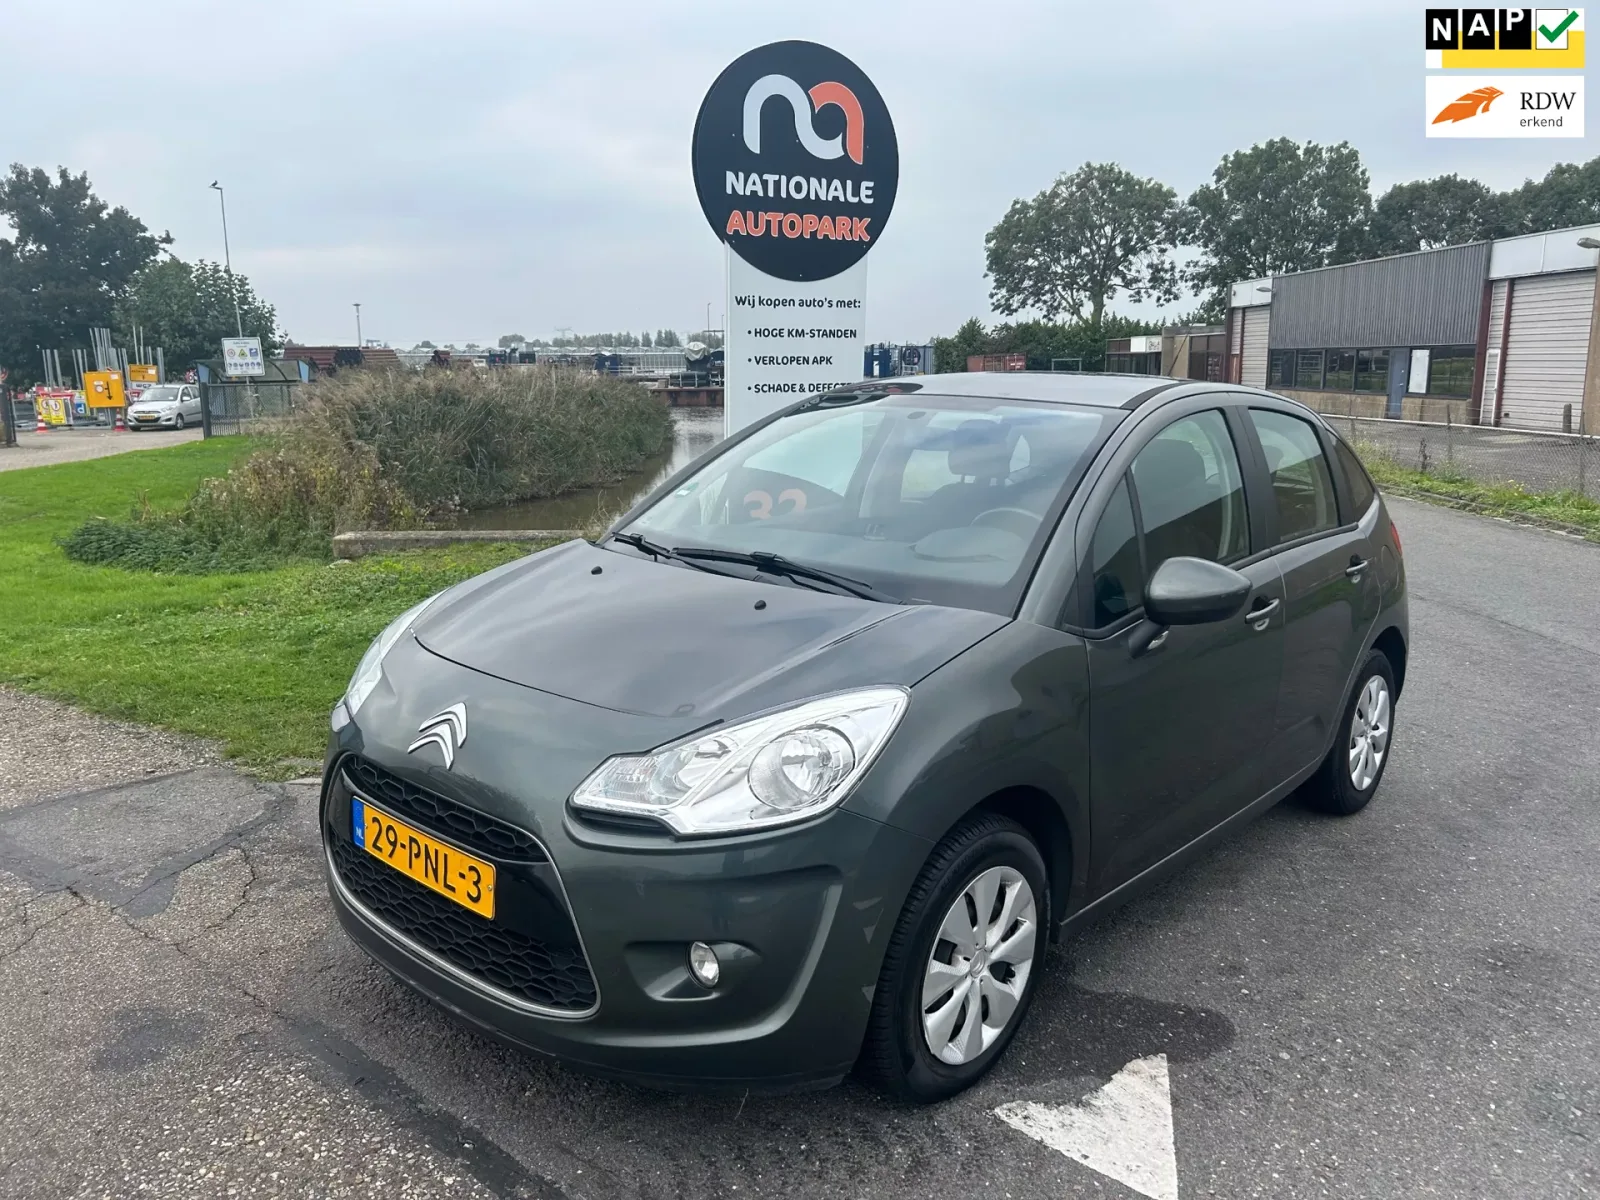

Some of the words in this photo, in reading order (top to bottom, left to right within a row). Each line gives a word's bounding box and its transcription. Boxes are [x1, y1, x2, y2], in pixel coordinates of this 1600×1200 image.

[725, 170, 875, 204] NATIONALE
[726, 209, 871, 242] AUTOPARK
[735, 295, 755, 309] Wij
[758, 296, 796, 309] kopen
[798, 297, 833, 308] auto's
[836, 299, 861, 308] met:
[754, 328, 785, 338] HOGE
[787, 328, 857, 339] KM-STANDEN
[754, 355, 810, 366] VERLOPEN
[812, 356, 833, 366] APK
[754, 383, 797, 393] SCHADE
[798, 383, 806, 393] &
[808, 382, 853, 393] DEFEC
[355, 826, 364, 840] NL
[371, 816, 482, 904] 29-PNL-3
